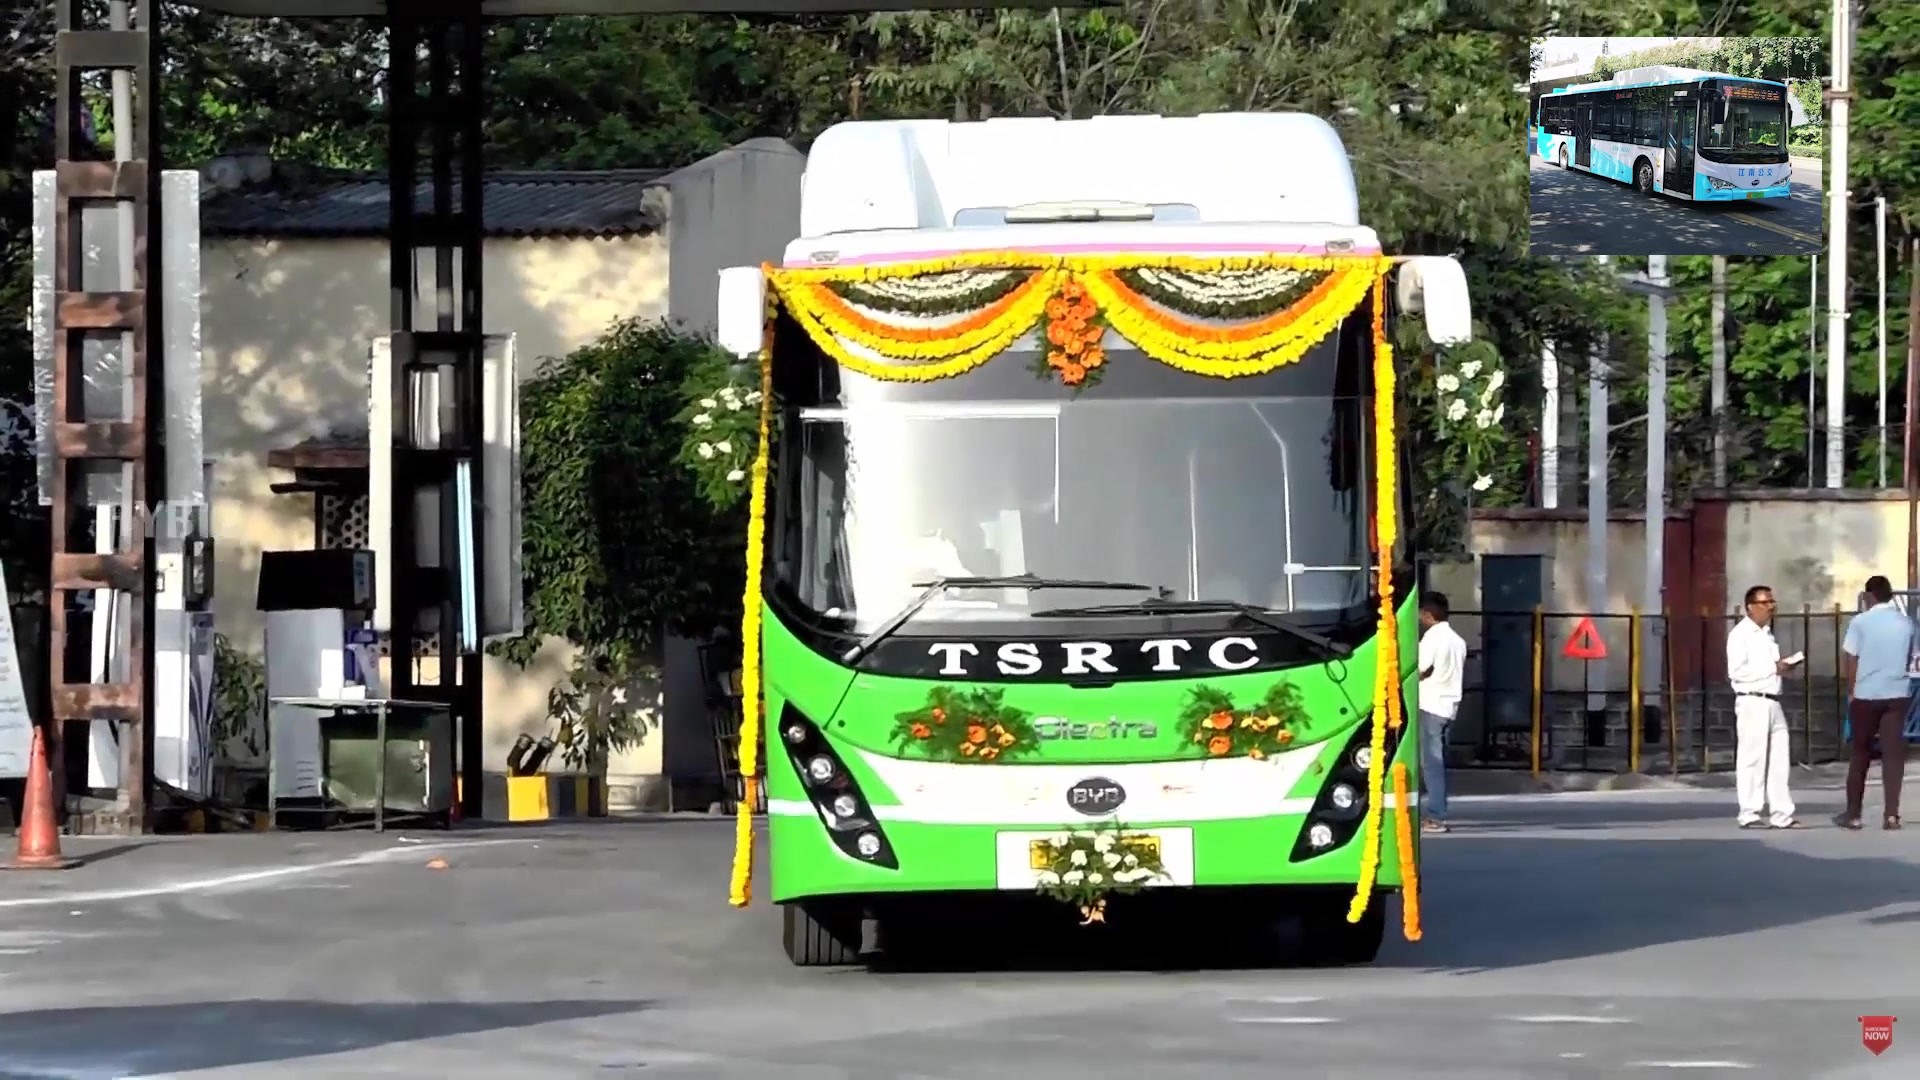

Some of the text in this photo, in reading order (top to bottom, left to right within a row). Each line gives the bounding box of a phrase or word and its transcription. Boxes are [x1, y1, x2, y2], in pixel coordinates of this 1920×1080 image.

[1738, 168, 1773, 177] 江南公交
[928, 637, 1260, 675] TSRTC
[1073, 787, 1119, 804] BYD
